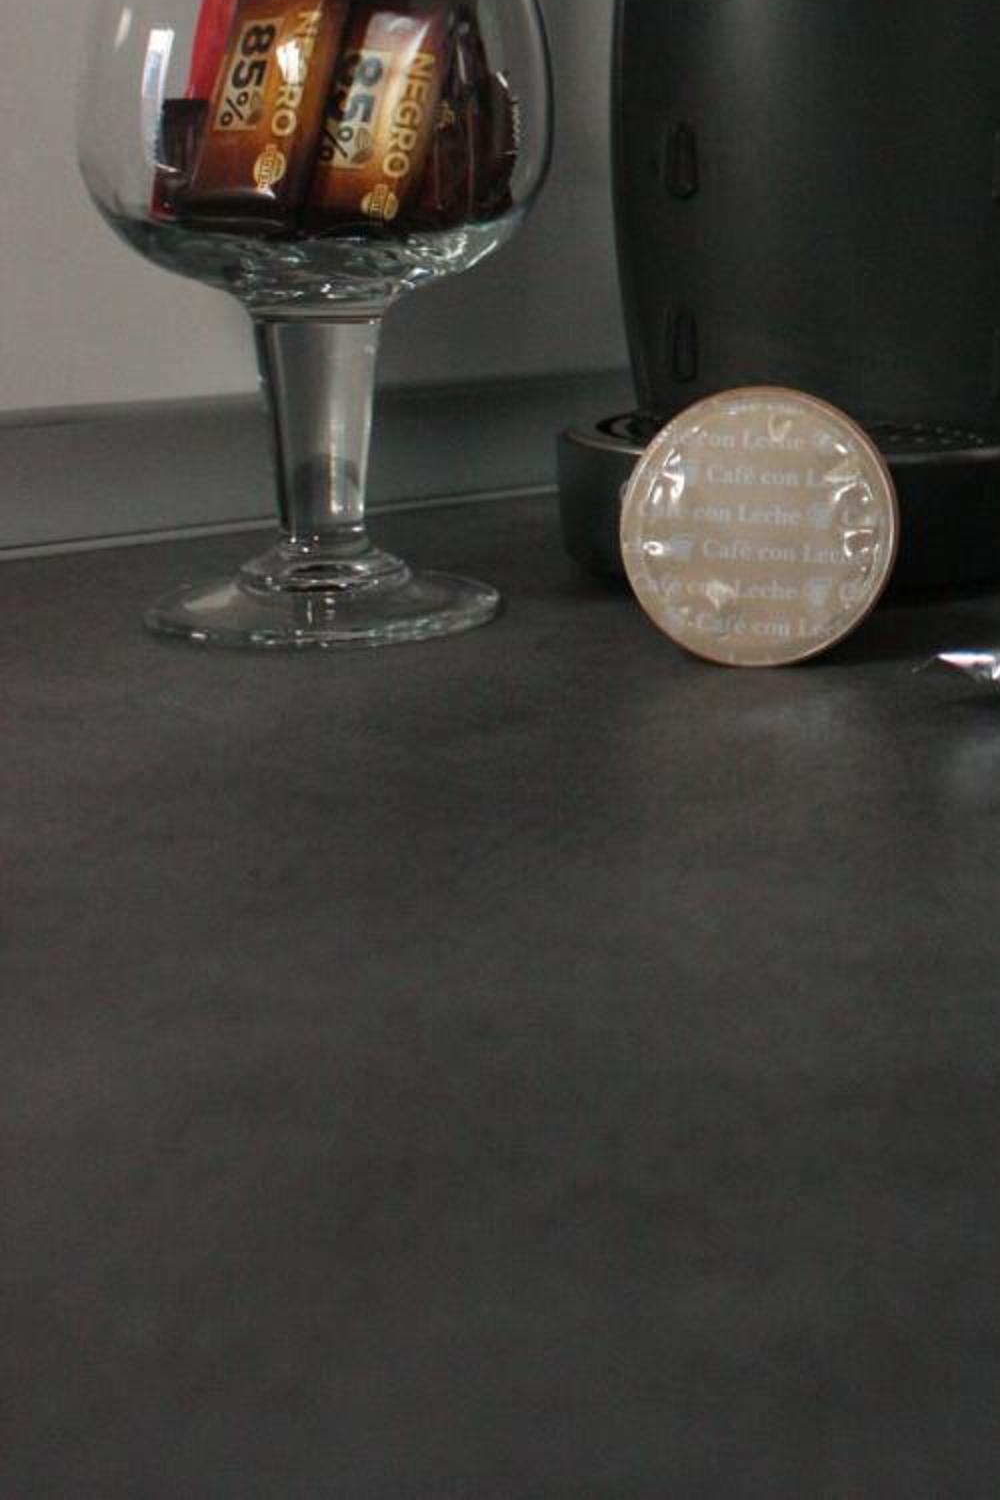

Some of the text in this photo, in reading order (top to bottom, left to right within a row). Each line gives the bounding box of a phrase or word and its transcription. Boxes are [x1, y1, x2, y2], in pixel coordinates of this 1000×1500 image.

[219, 24, 277, 129] 85%
[380, 52, 435, 180] NEGRO
[706, 464, 752, 486] Café
[760, 468, 799, 486] con
[692, 505, 732, 523] con
[737, 502, 802, 526] Leche
[702, 538, 753, 561] Café
[756, 544, 797, 564] con
[734, 578, 800, 601] Leche
[751, 621, 793, 637] con
